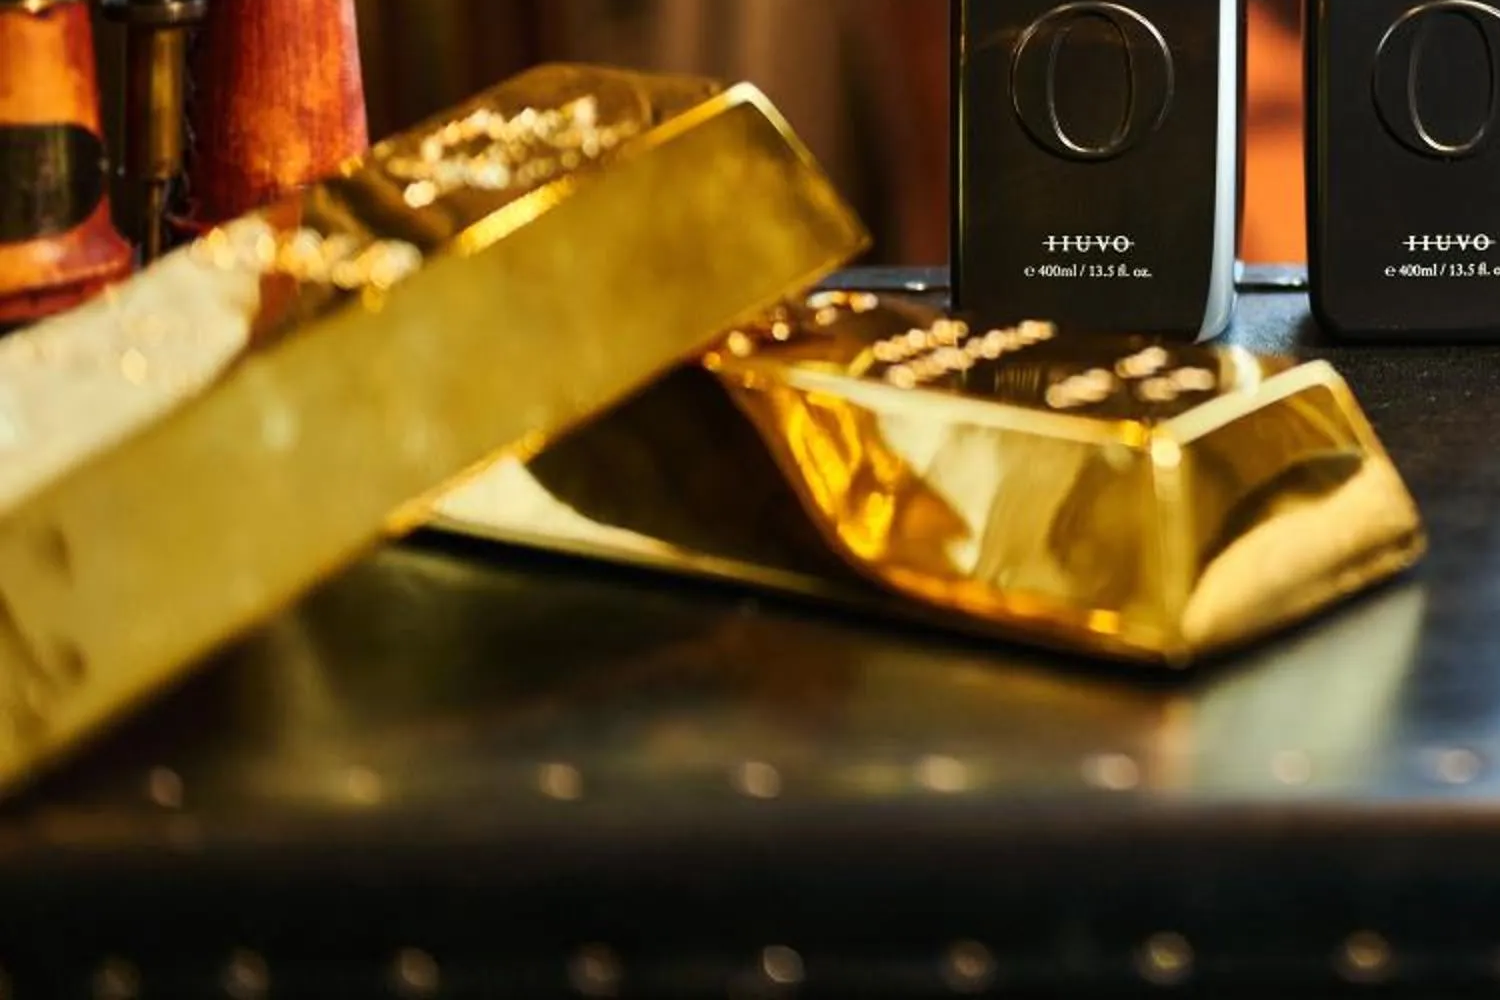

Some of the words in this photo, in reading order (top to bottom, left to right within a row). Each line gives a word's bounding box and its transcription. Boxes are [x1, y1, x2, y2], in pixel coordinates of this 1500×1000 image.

[1038, 264, 1076, 277] 400ml
[1090, 265, 1114, 277] 13.5
[1133, 268, 1152, 277] oz.
[1399, 264, 1437, 276] 400ml
[1450, 264, 1475, 276] 13.5
